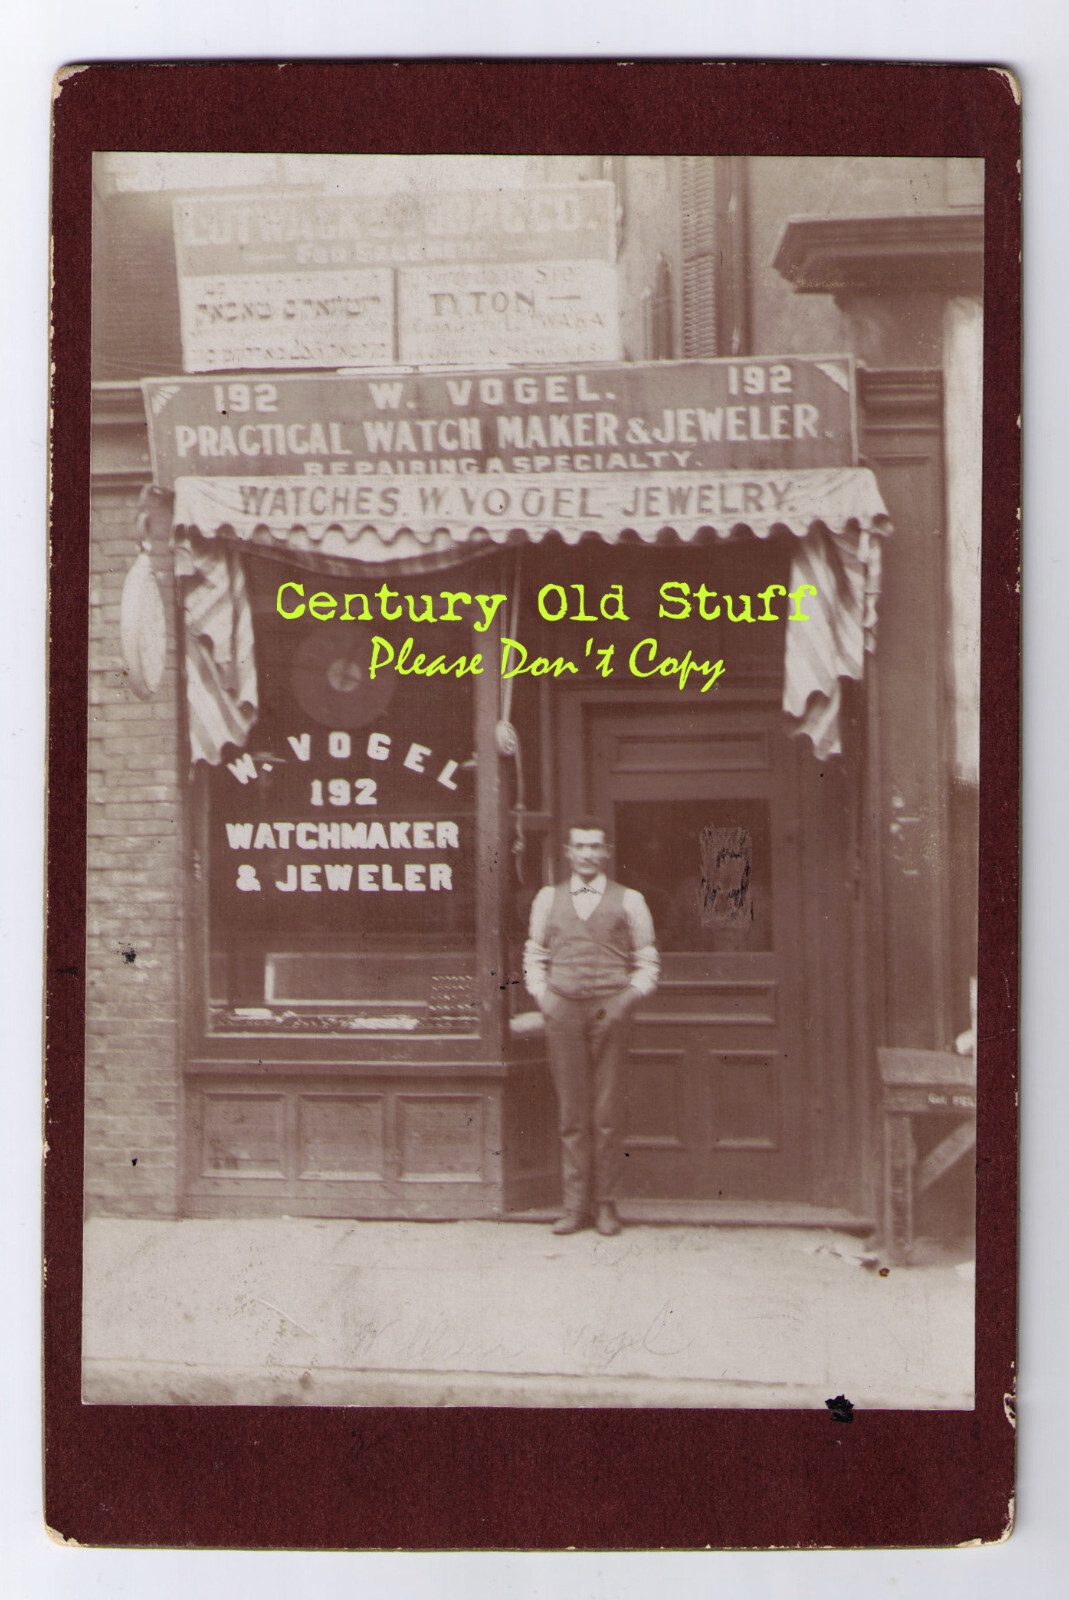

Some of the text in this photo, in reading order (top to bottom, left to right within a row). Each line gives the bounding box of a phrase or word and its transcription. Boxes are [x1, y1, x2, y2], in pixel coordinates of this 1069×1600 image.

[214, 364, 792, 413] 192 W. VOGEL. 192
[175, 422, 352, 457] PRACTICAL
[362, 418, 483, 453] WATCH
[497, 411, 620, 450] MAKER
[303, 457, 480, 475] REPAIRING
[485, 456, 505, 474] A
[461, 486, 604, 519] VOGEL
[226, 731, 460, 791] W. VOGEL
[310, 778, 378, 806] 192
[225, 821, 460, 850] WATCHMAKER
[236, 863, 453, 892] & JEWELER
